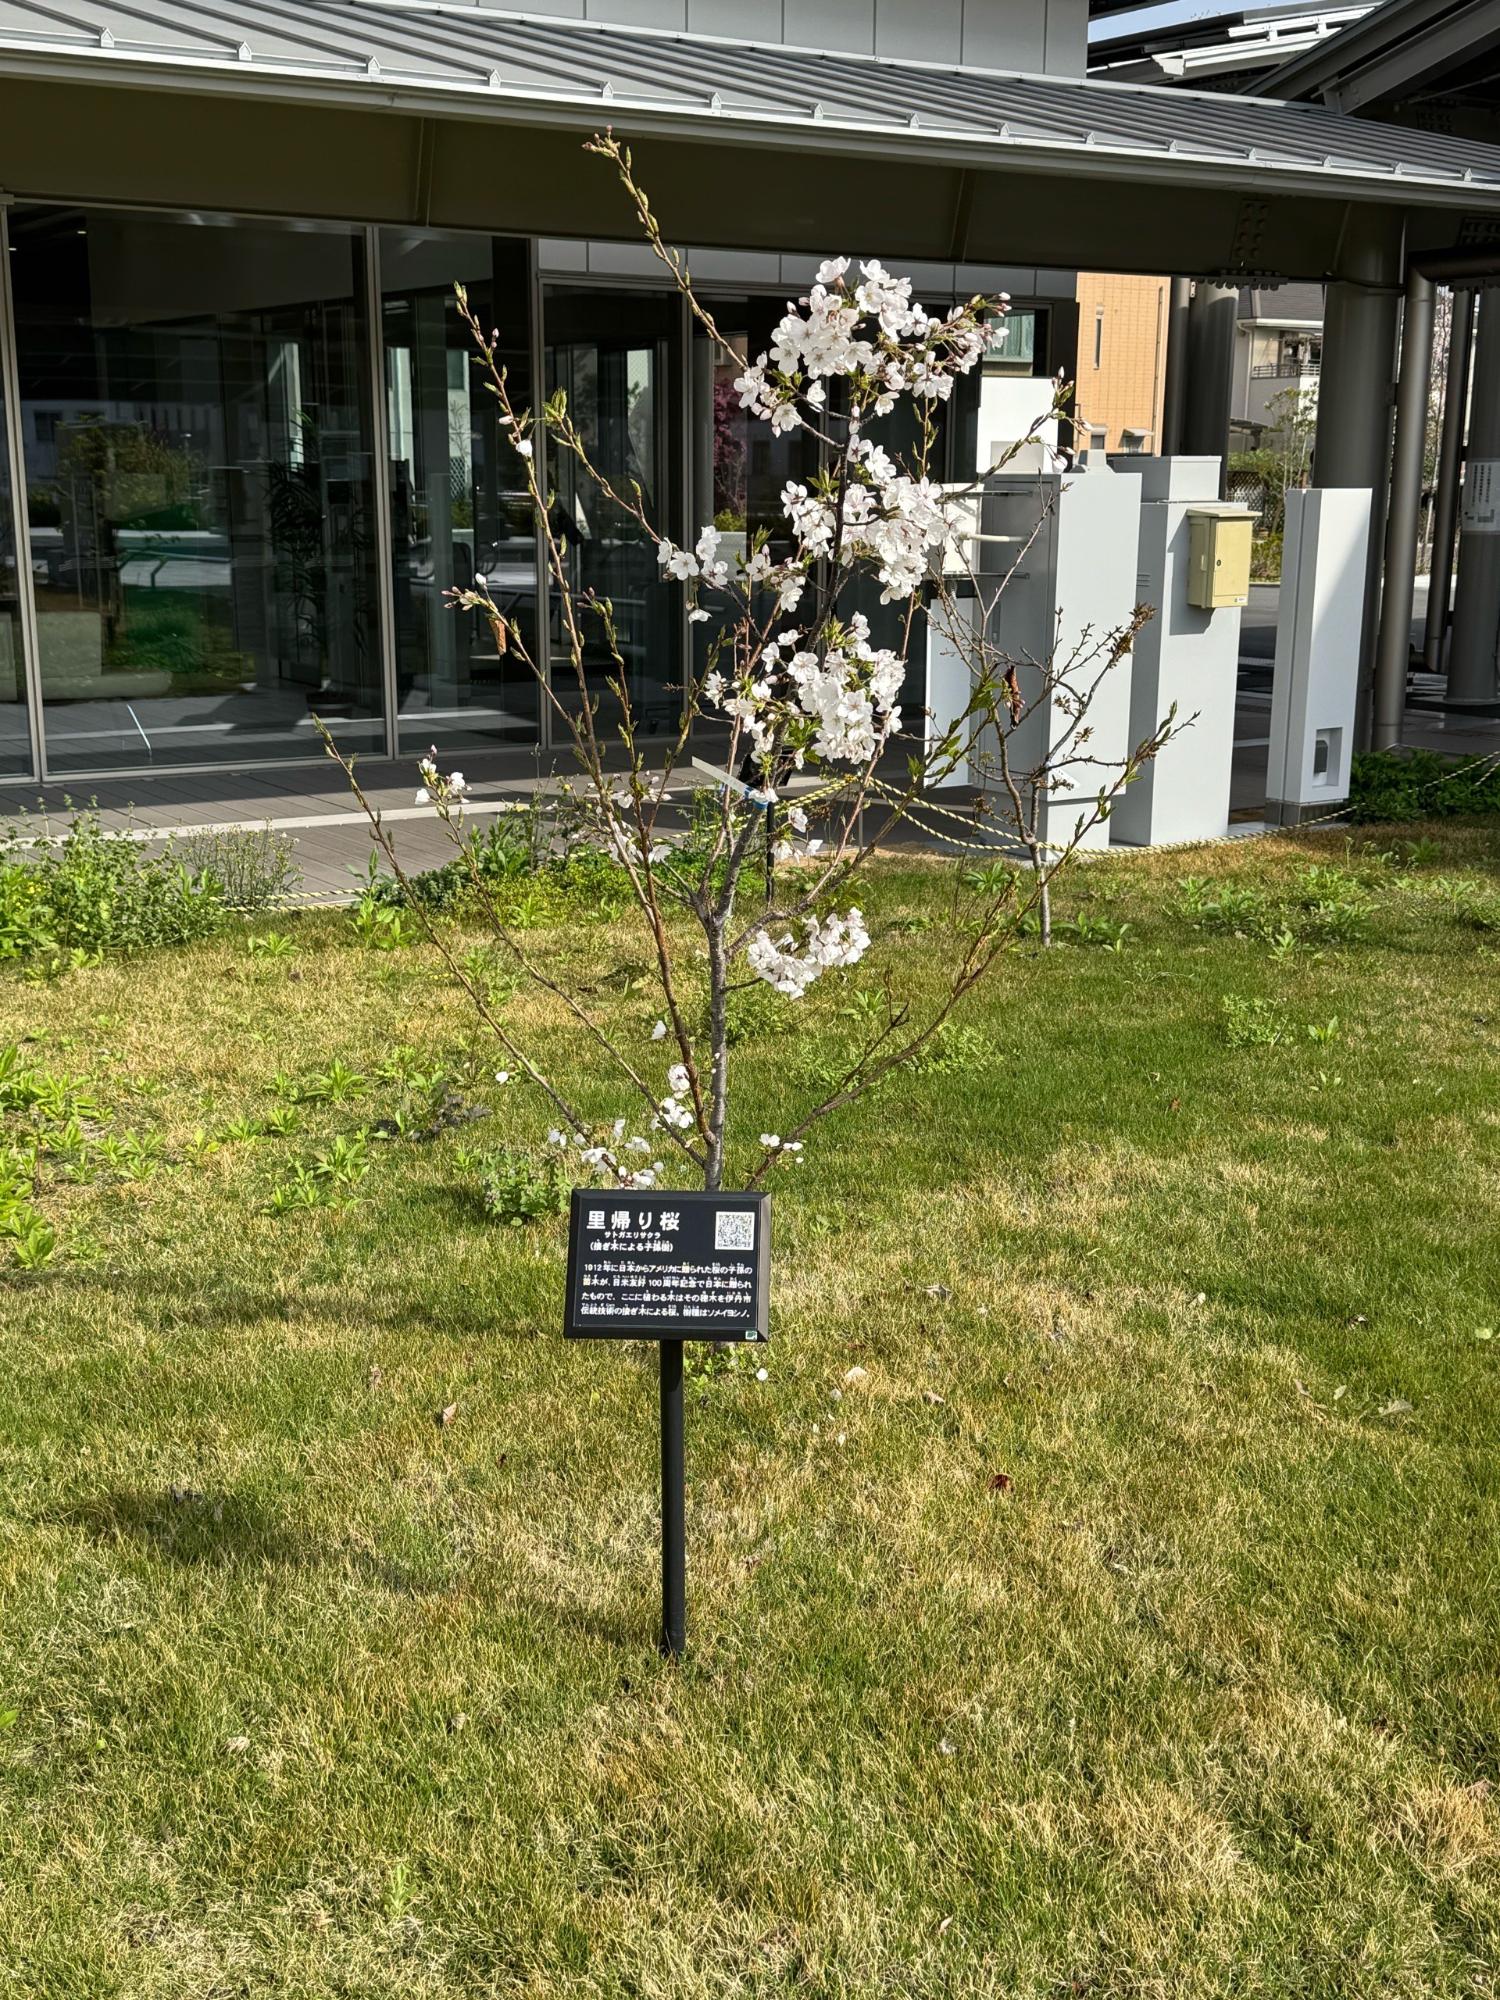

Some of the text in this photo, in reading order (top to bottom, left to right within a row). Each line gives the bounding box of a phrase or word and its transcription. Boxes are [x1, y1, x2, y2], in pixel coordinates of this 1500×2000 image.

[586, 1210, 680, 1231] 里帰り桜
[604, 1231, 661, 1239] サトガエリサクラ
